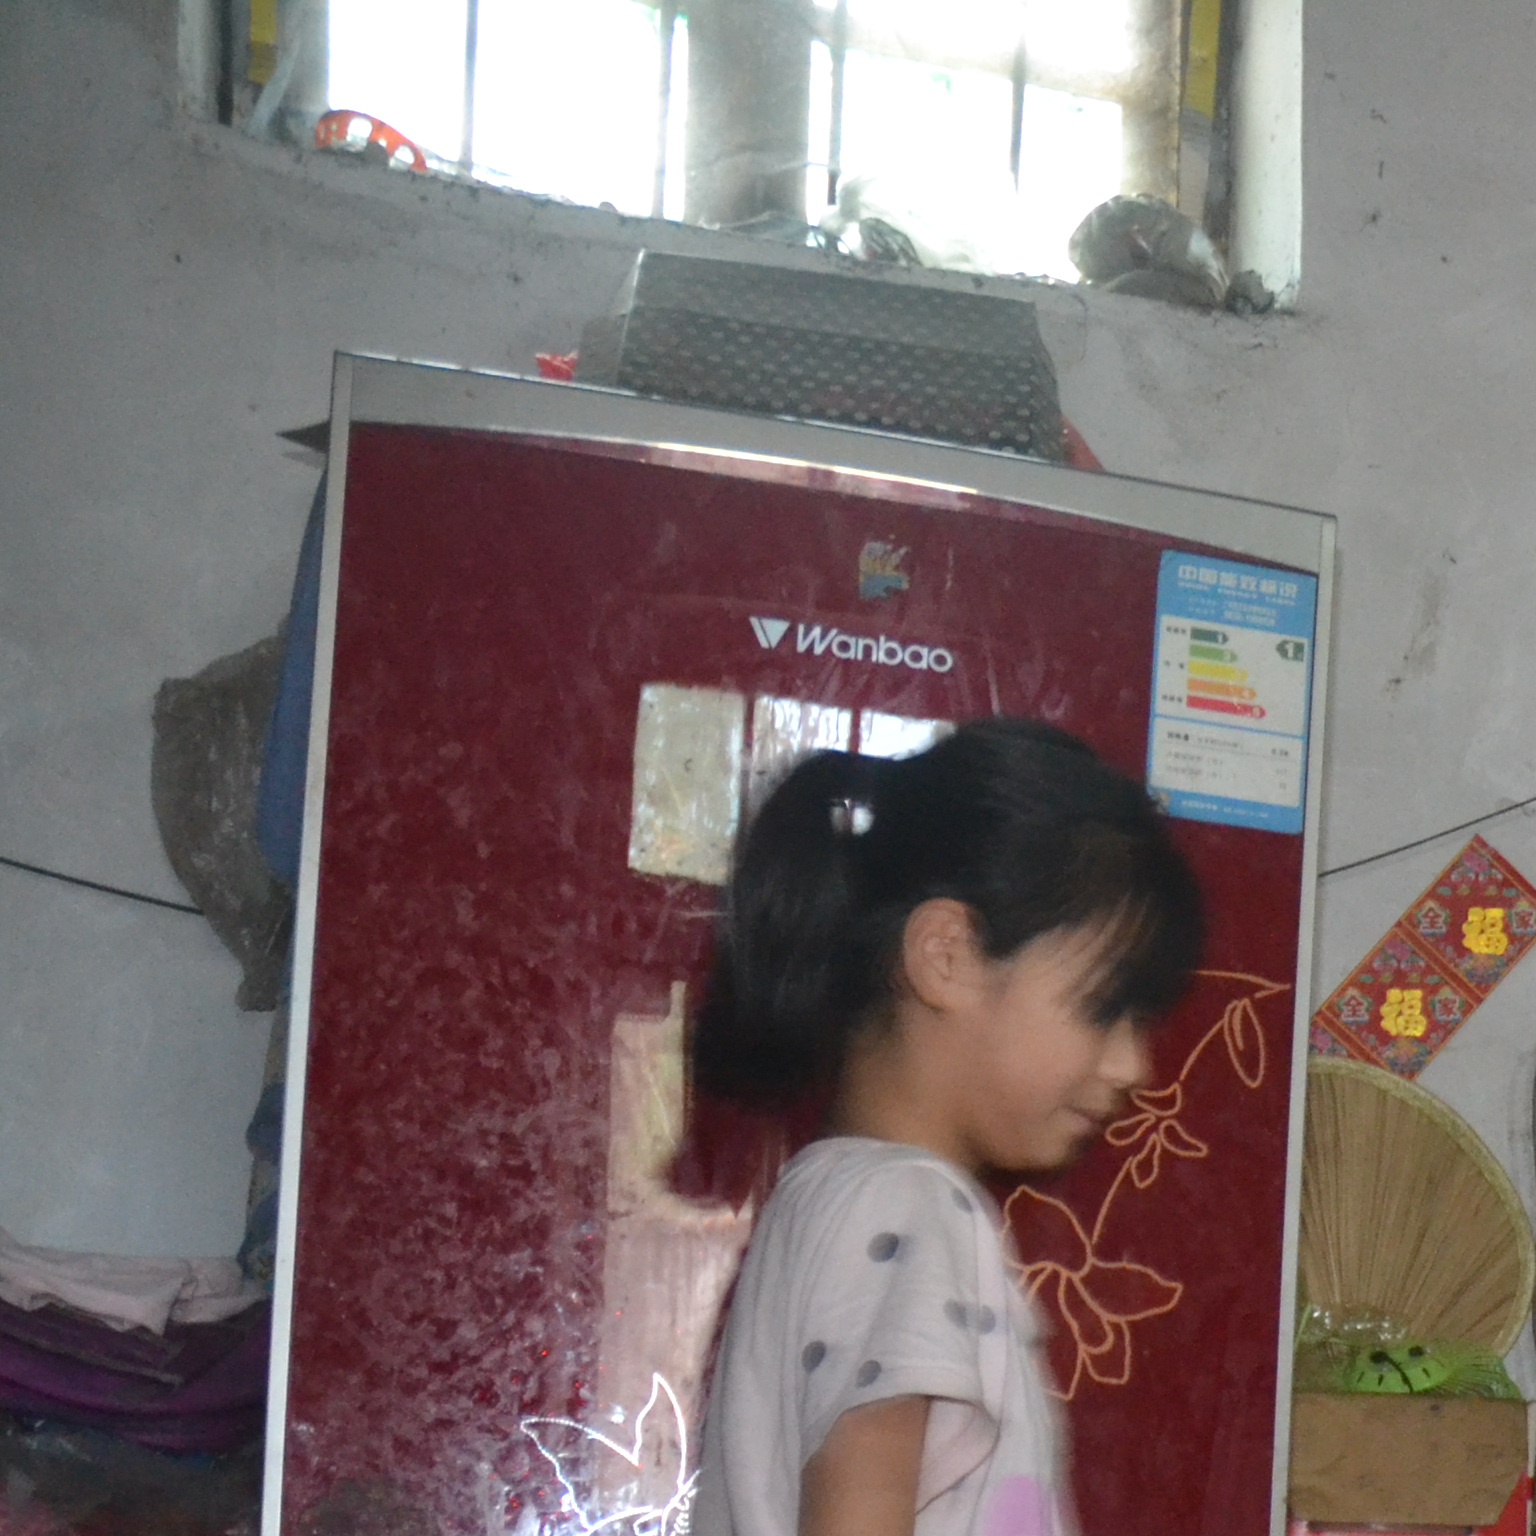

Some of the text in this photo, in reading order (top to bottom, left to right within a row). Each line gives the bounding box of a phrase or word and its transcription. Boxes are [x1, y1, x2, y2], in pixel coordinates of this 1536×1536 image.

[796, 622, 954, 674] Wanbao
[1461, 906, 1509, 956] 福
[1379, 988, 1428, 1037] 福
